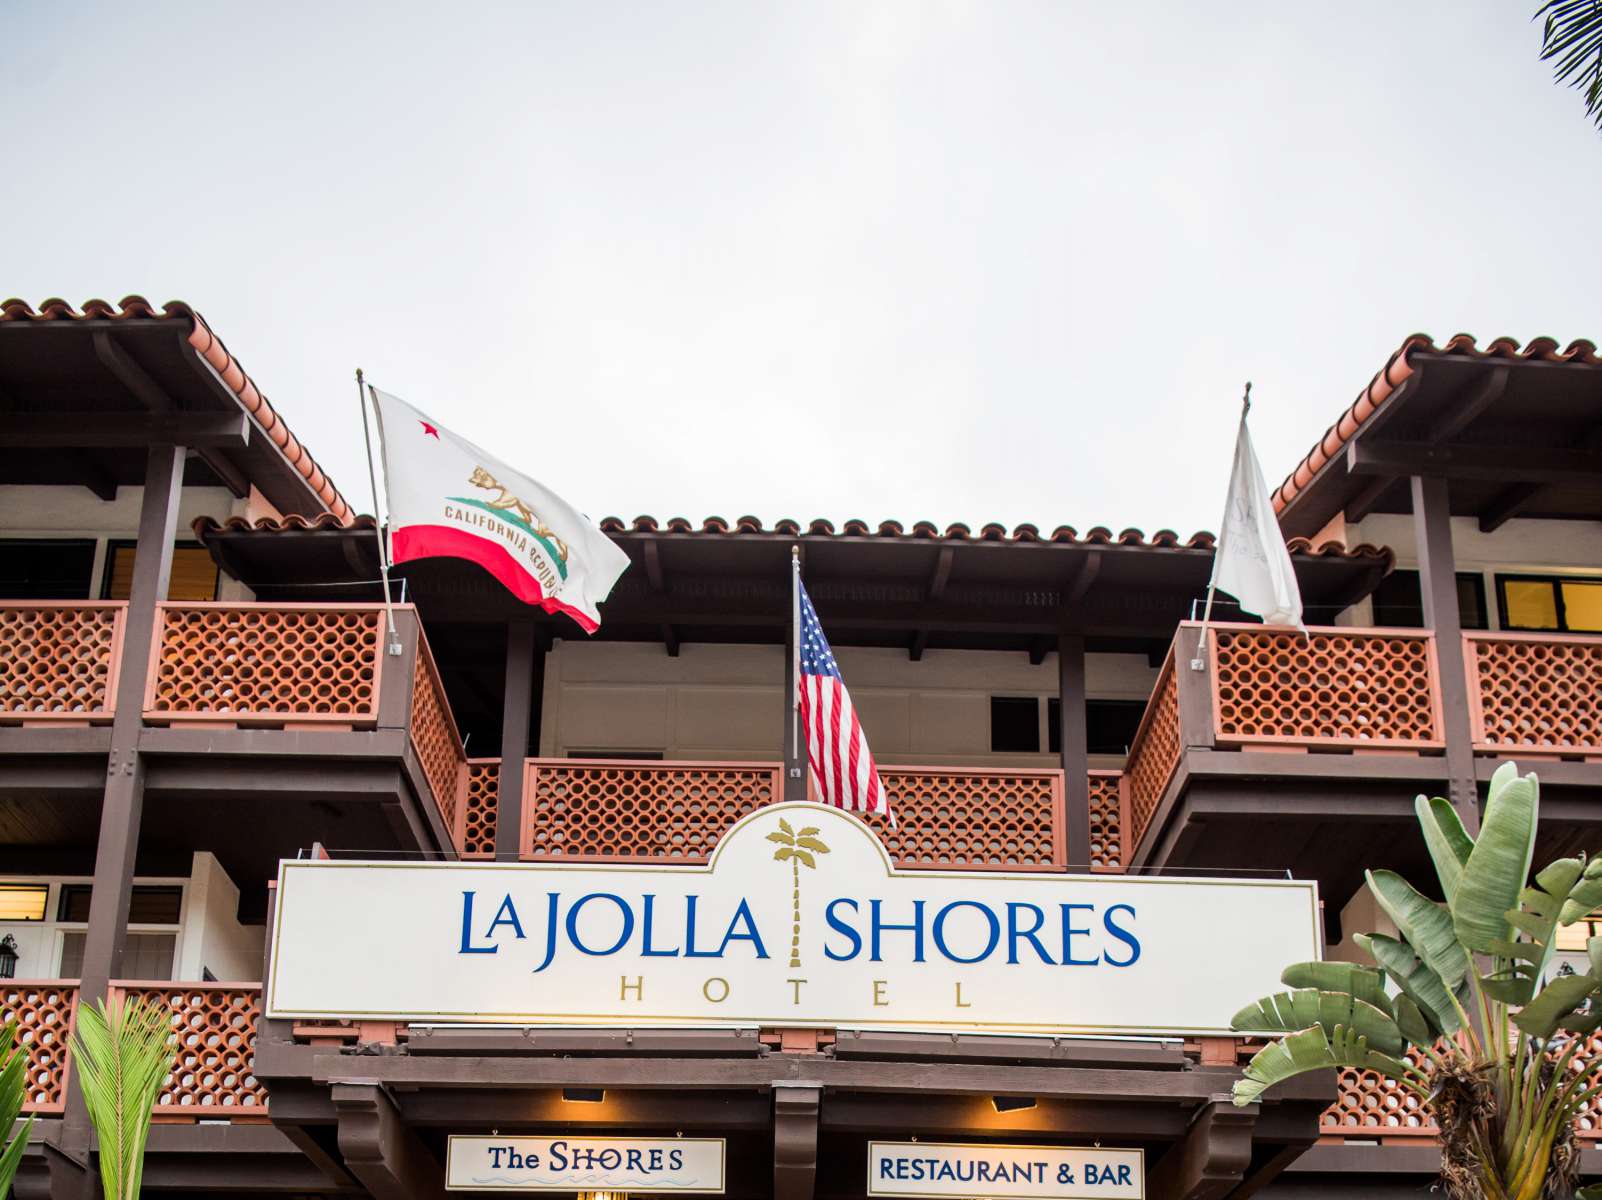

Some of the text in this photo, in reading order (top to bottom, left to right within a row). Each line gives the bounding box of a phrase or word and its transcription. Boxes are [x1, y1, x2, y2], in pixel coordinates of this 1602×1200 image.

[445, 506, 563, 598] CALIFORNIA REPUB
[458, 891, 1142, 973] LA JOLLA SHORES
[620, 976, 972, 1007] HOTEL
[488, 1141, 683, 1174] The SHORES
[879, 1158, 1133, 1186] RESTAURANT & BAR
